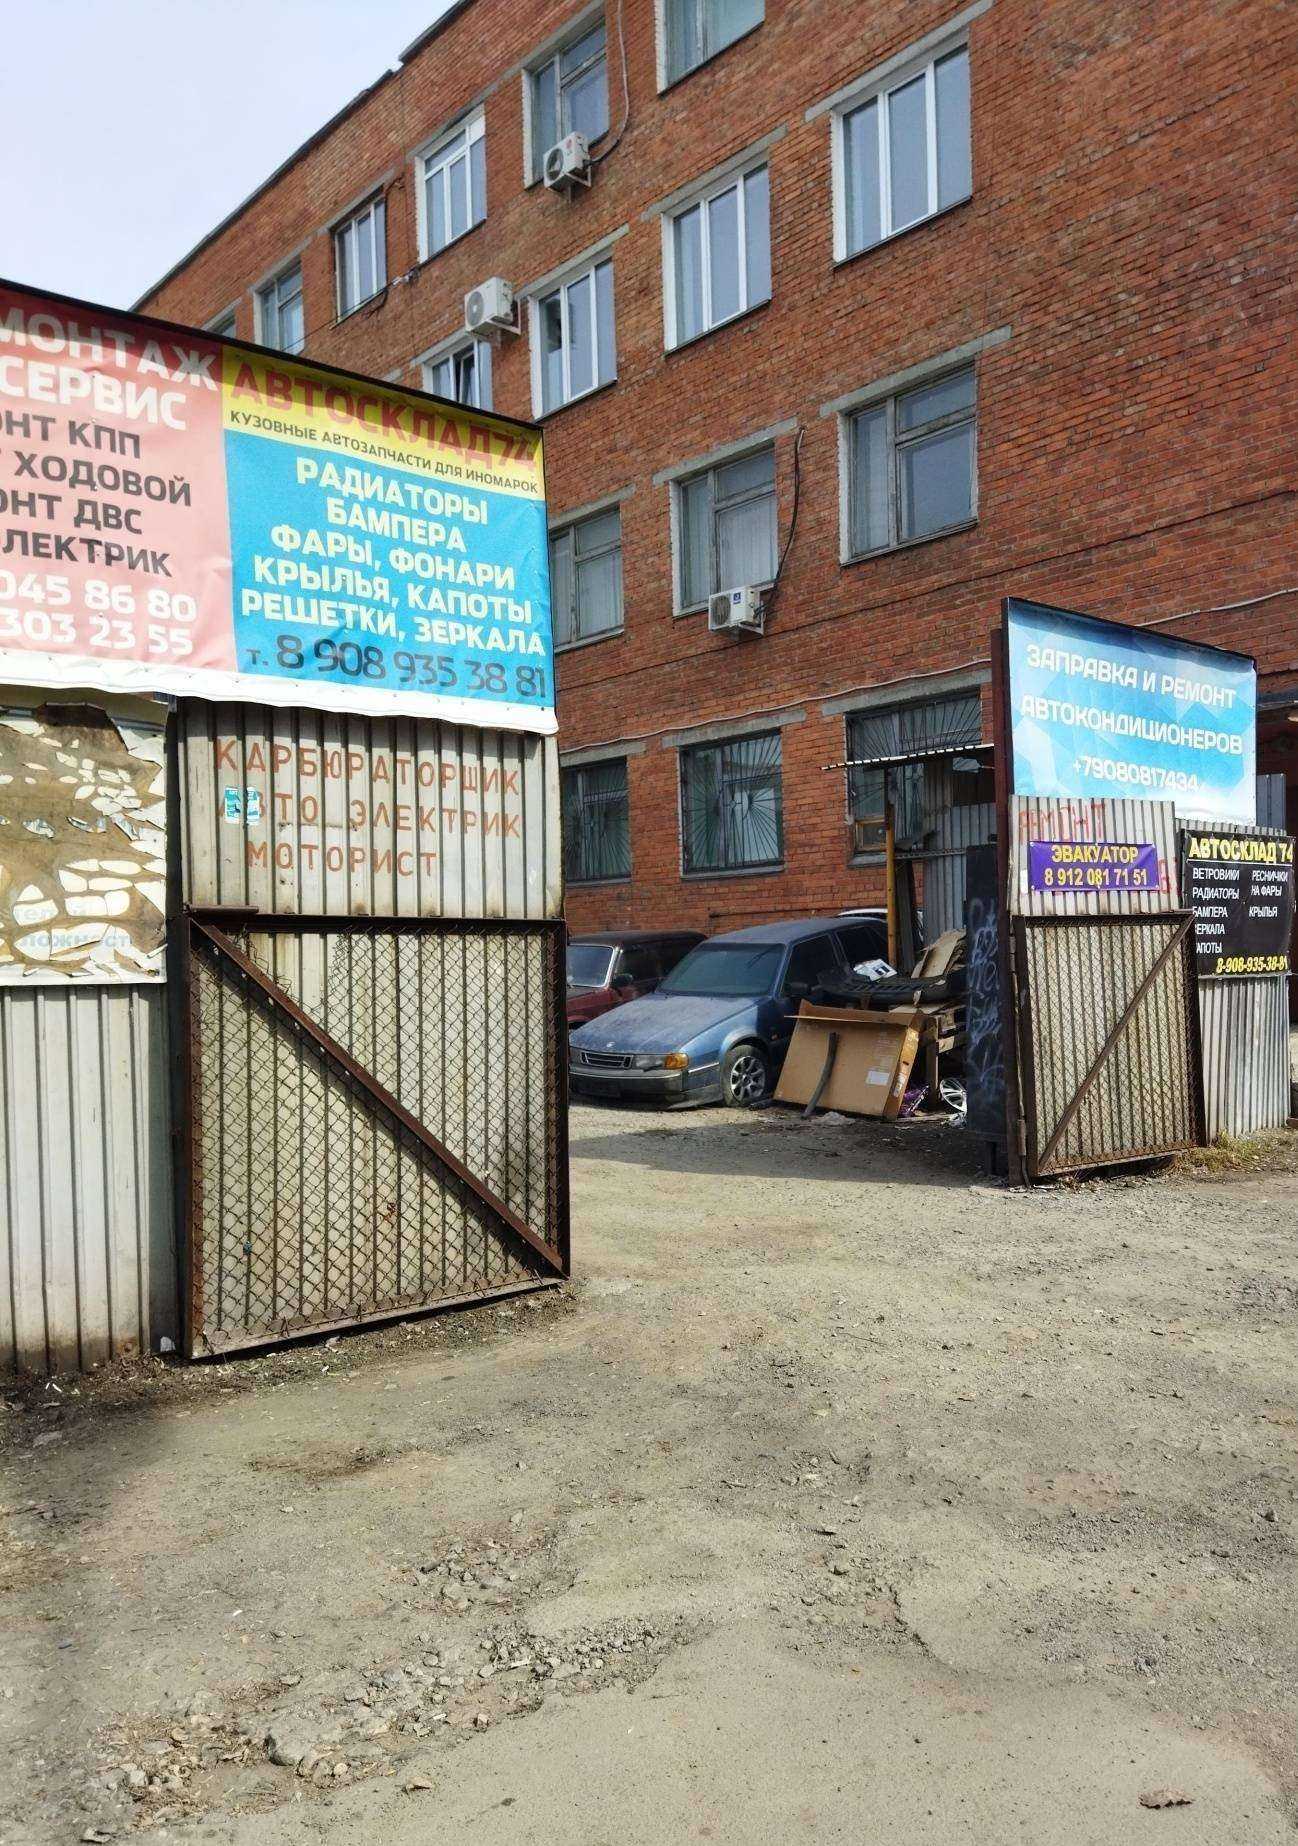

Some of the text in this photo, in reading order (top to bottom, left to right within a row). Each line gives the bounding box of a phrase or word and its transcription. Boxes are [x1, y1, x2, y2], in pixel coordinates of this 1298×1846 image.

[0, 356, 186, 430] СЕРВИС
[0, 410, 141, 459] НТ КПП
[229, 410, 538, 494] КУЗОВНЫЕ АВТОЗАПЧАСТИ ДЛЯ ИНОМАРОК
[14, 450, 191, 507] ХОДОВОЙ
[296, 457, 488, 525] РАДИАТОРЫ
[74, 499, 143, 535] ДВС
[326, 497, 467, 553] БАМПЕРА
[2, 528, 173, 578] ЛЕКТРИК
[270, 523, 515, 591] ФАРЫ, ФОНАРИ
[84, 579, 137, 616] 86
[147, 588, 198, 622] 80
[254, 555, 532, 624] КРЫЛЬЯ, КАПОТЫ
[0, 605, 194, 656] 303 23 55
[241, 588, 546, 656] РЕШЕТКИ, ЗЕРКАЛА
[276, 634, 304, 670] 8
[313, 638, 386, 680] 908
[394, 651, 458, 687] 935
[464, 659, 508, 693] 38
[515, 665, 547, 699] 81
[1026, 644, 1237, 709] ЗАПРАВКА И РЕМОНТ
[1020, 695, 1244, 755] АВТОКОНДИЦИОНЕРОВ
[213, 739, 519, 796] КАРБЮРАТОРЩИК
[349, 799, 520, 839] ЭЛЕКТРИК
[245, 840, 437, 877] МОТОРИСТ
[1051, 844, 1139, 864] ЭВАКУАТОР
[1188, 838, 1294, 864] АВТОСКЛАД 74
[1192, 867, 1240, 881] ВЕТРОВИКИ
[1044, 868, 1053, 886] 8
[1057, 868, 1084, 886] 912
[1086, 868, 1110, 886] 081
[1114, 869, 1129, 886] 71
[1133, 869, 1148, 886] 51
[1192, 887, 1240, 901] РАДИАТОРЫ
[1250, 885, 1283, 898] НА ФАРЫ
[1251, 870, 1289, 883] РЕСНИЧКИ
[1192, 906, 1228, 918] БАМПЕРА
[1249, 906, 1278, 918] КРЫЛЬЯ
[1196, 942, 1223, 954] АПОТЫ
[1216, 956, 1289, 974] 8-908-935-38-81
